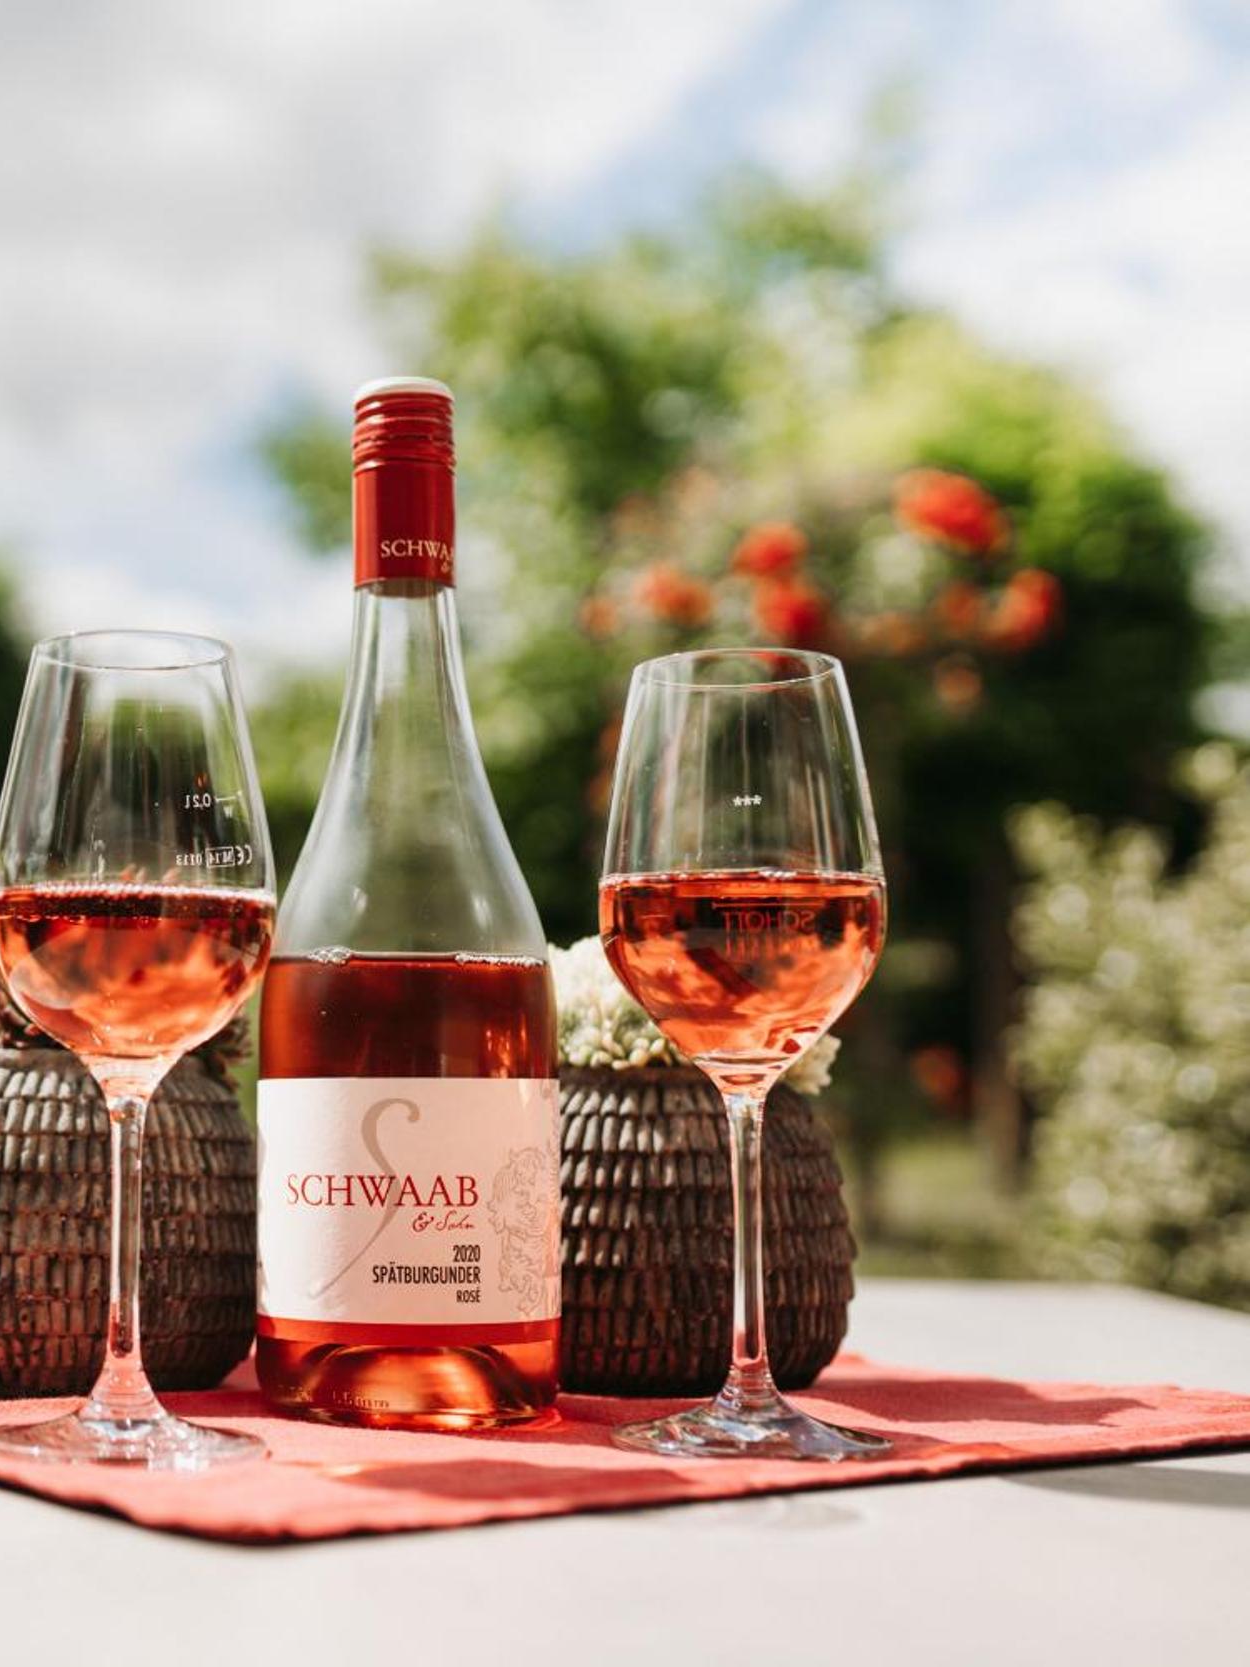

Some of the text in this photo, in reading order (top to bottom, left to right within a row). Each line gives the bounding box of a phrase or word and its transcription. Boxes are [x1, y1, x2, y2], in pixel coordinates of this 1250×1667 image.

[287, 1174, 479, 1208] SCHWAAB
[453, 1244, 481, 1262] 2020
[372, 1261, 481, 1284] SPÄTBURGUNDER
[456, 1287, 481, 1303] ROSÉ
